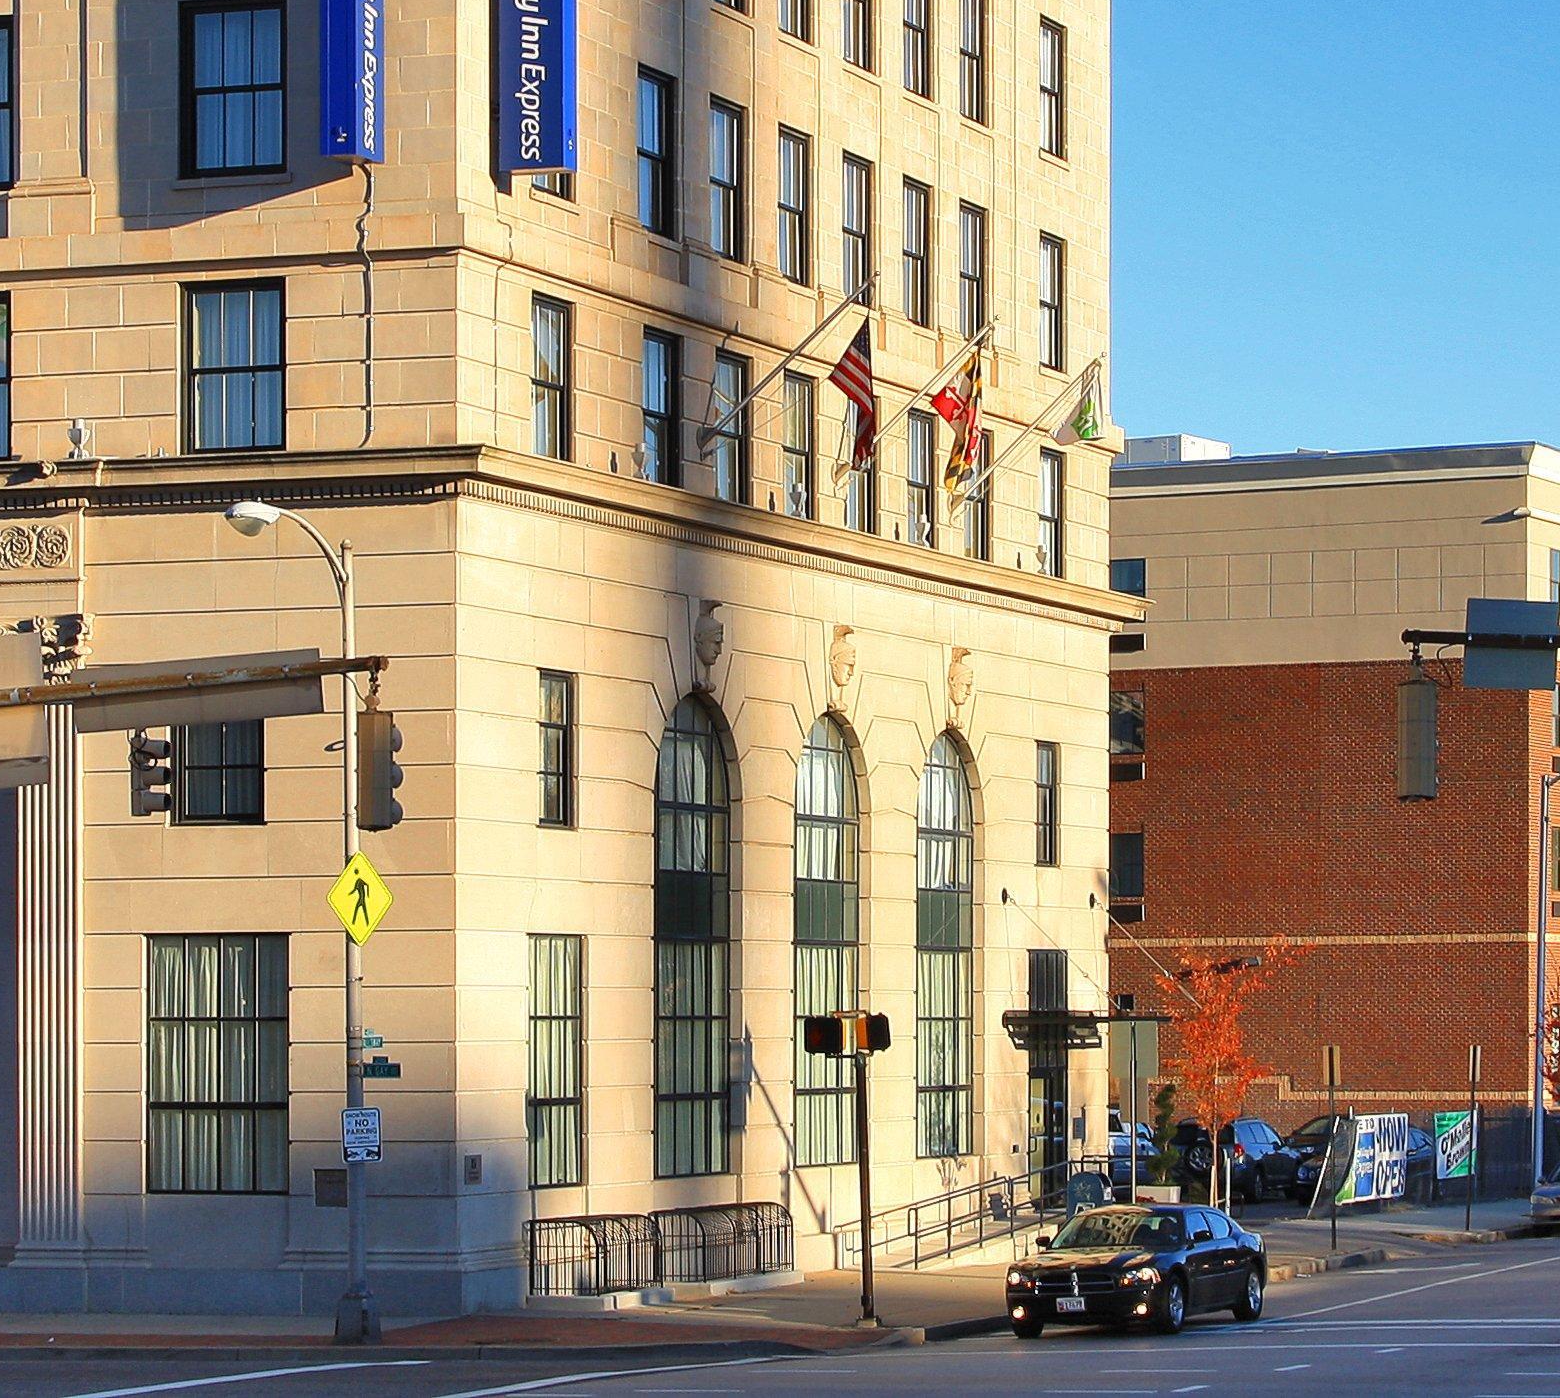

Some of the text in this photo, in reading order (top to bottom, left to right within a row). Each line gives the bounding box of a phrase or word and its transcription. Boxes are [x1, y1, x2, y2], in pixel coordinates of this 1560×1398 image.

[362, 2, 379, 50] Inn
[520, 16, 549, 61] Inn
[360, 50, 378, 151] Express
[514, 63, 547, 161] Express
[354, 1118, 370, 1127] NO
